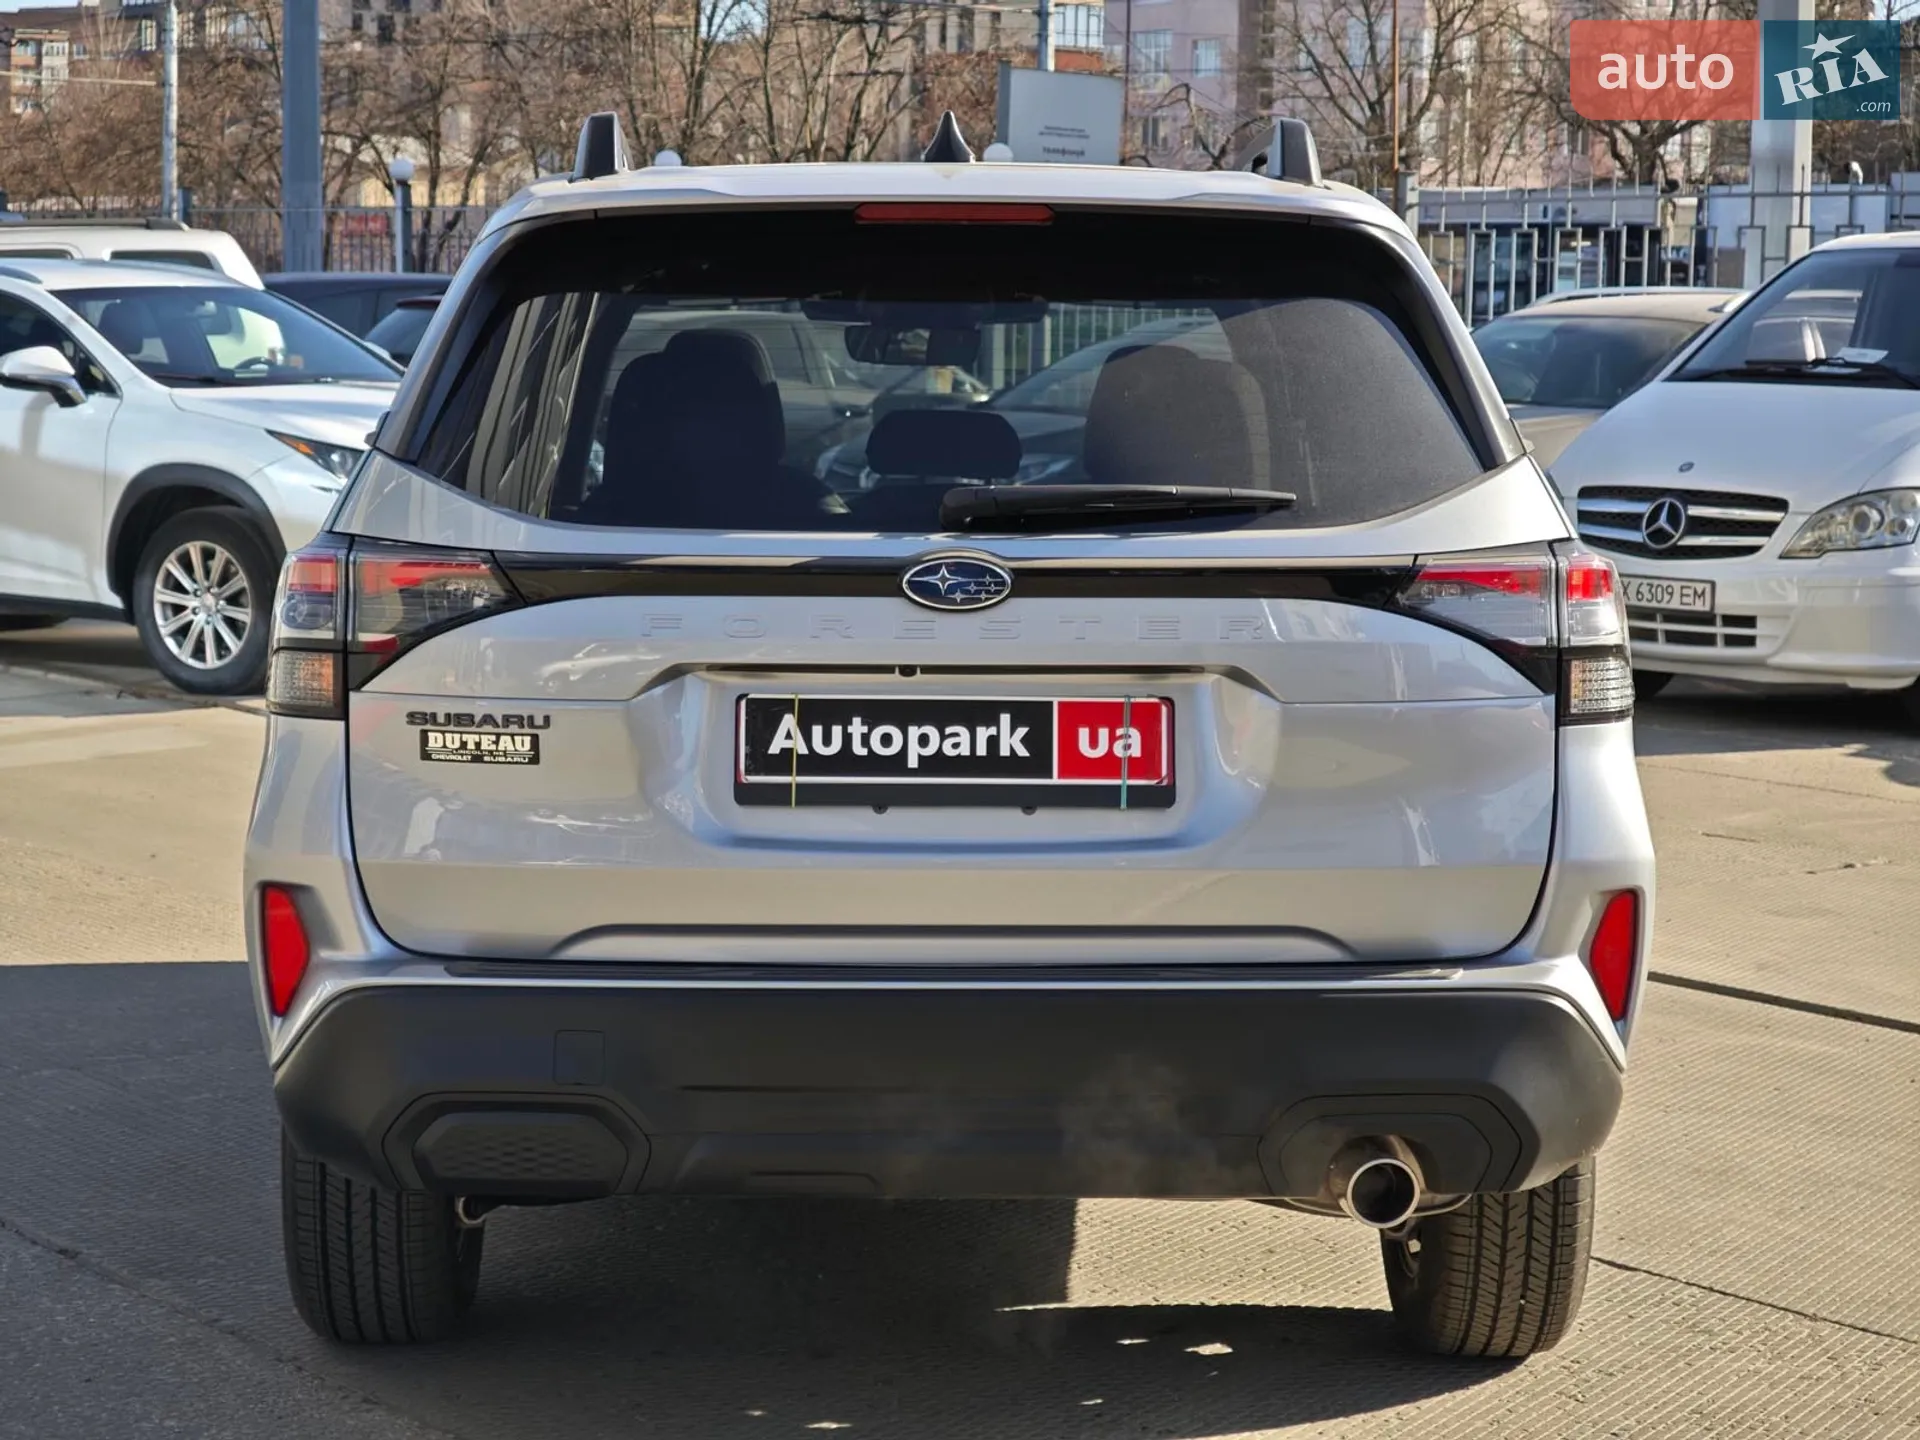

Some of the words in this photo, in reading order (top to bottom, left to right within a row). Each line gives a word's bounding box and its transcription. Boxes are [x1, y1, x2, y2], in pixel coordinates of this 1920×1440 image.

[1636, 582, 1674, 604] 6309
[1680, 586, 1706, 607] EM
[641, 614, 1267, 640] FORESTER
[406, 711, 551, 729] SUBARU
[428, 732, 531, 751] DUTEAU
[767, 712, 1030, 769] Autopark
[1077, 720, 1142, 759] ua
[431, 753, 472, 761] CHEVROLET
[483, 755, 529, 763] SUBARU
